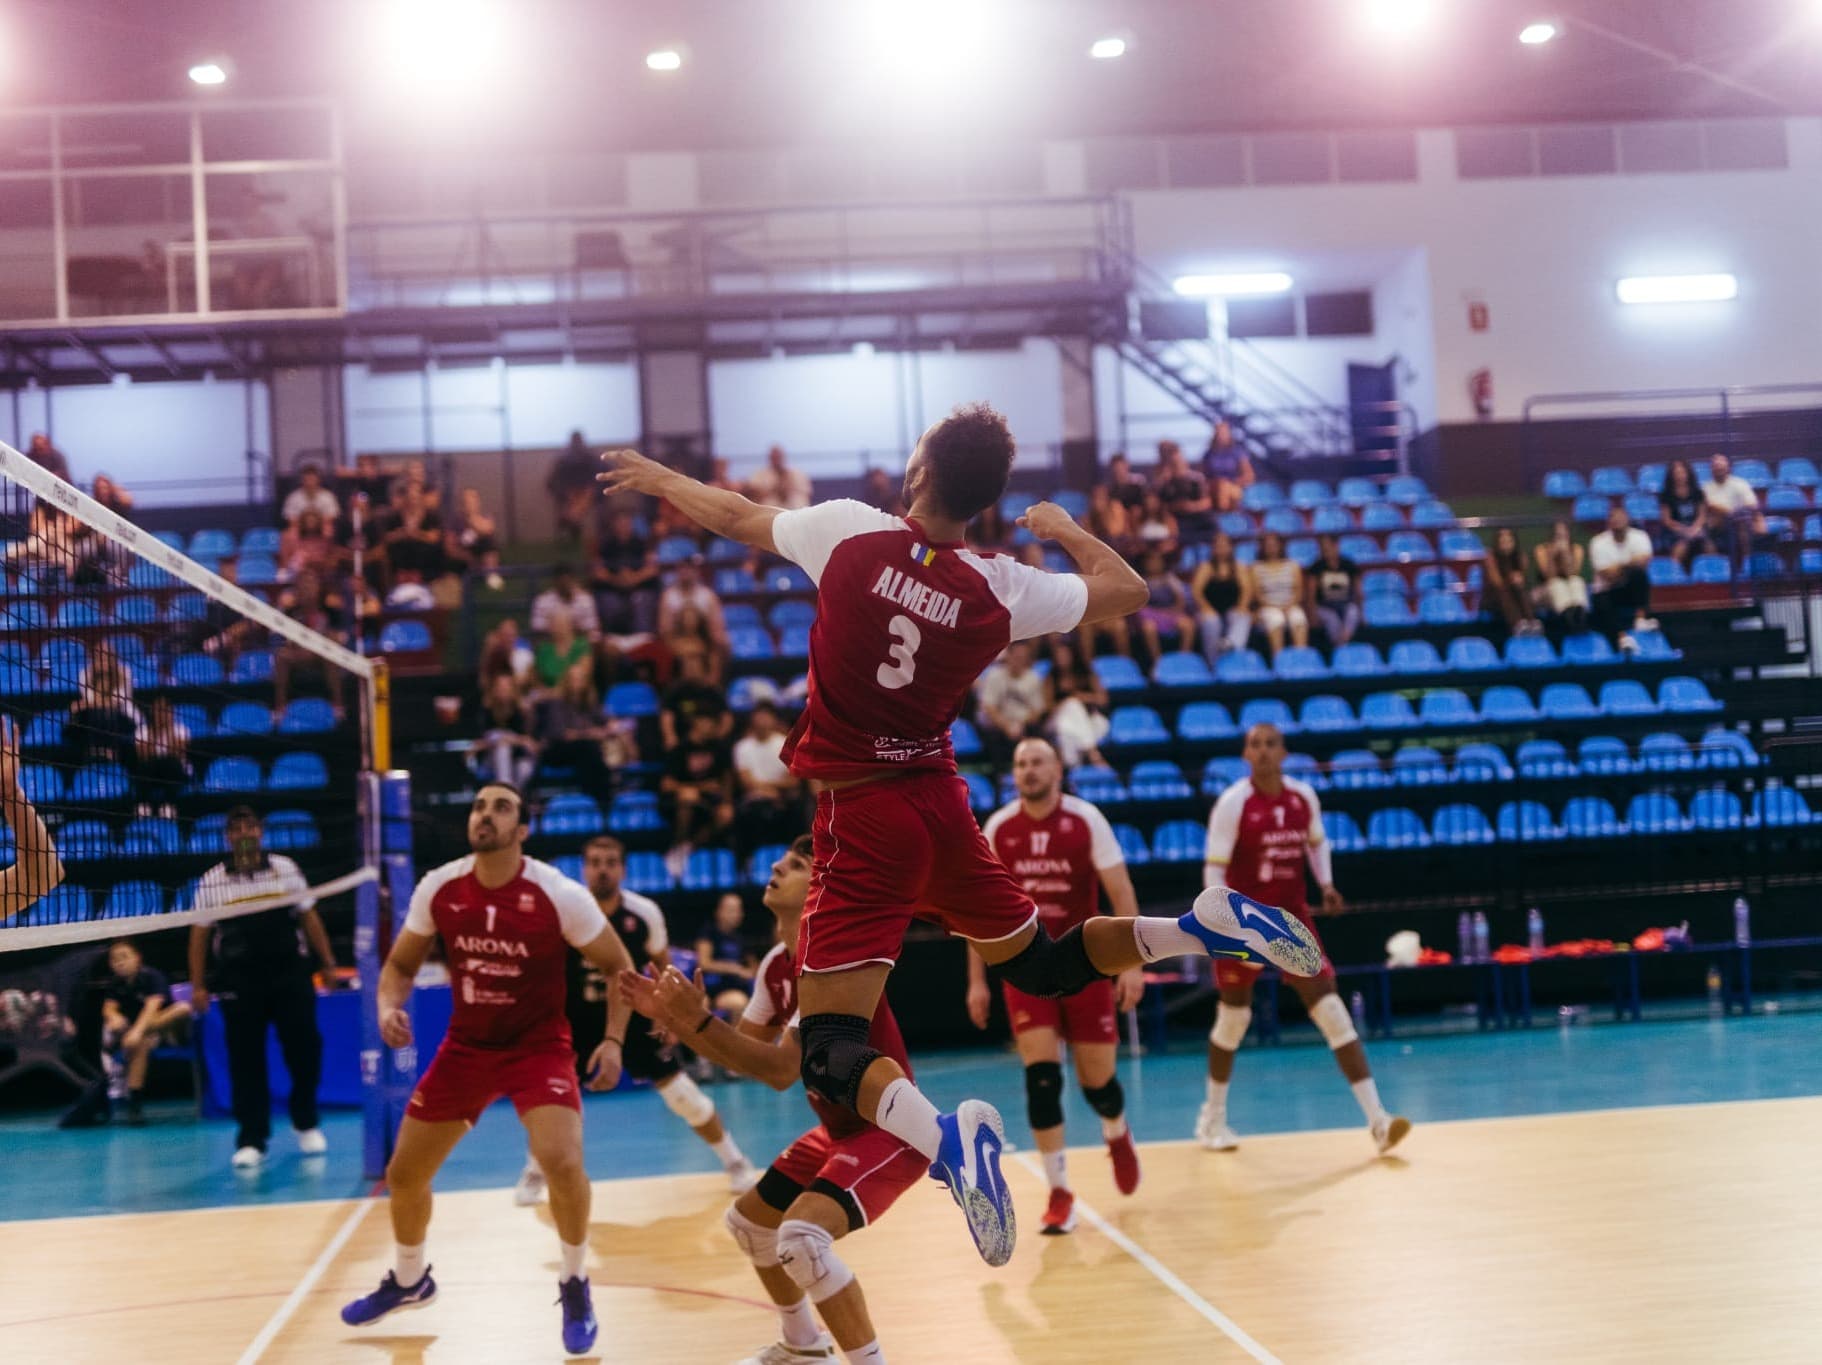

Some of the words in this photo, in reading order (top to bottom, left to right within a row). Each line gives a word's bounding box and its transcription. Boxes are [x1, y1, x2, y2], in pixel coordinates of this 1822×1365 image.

[872, 566, 962, 629] ALMEIDA
[876, 614, 922, 690] 3
[1273, 805, 1286, 828] 1
[1013, 858, 1073, 876] ARONA
[485, 904, 497, 933] 1
[454, 935, 529, 958] ARONA
